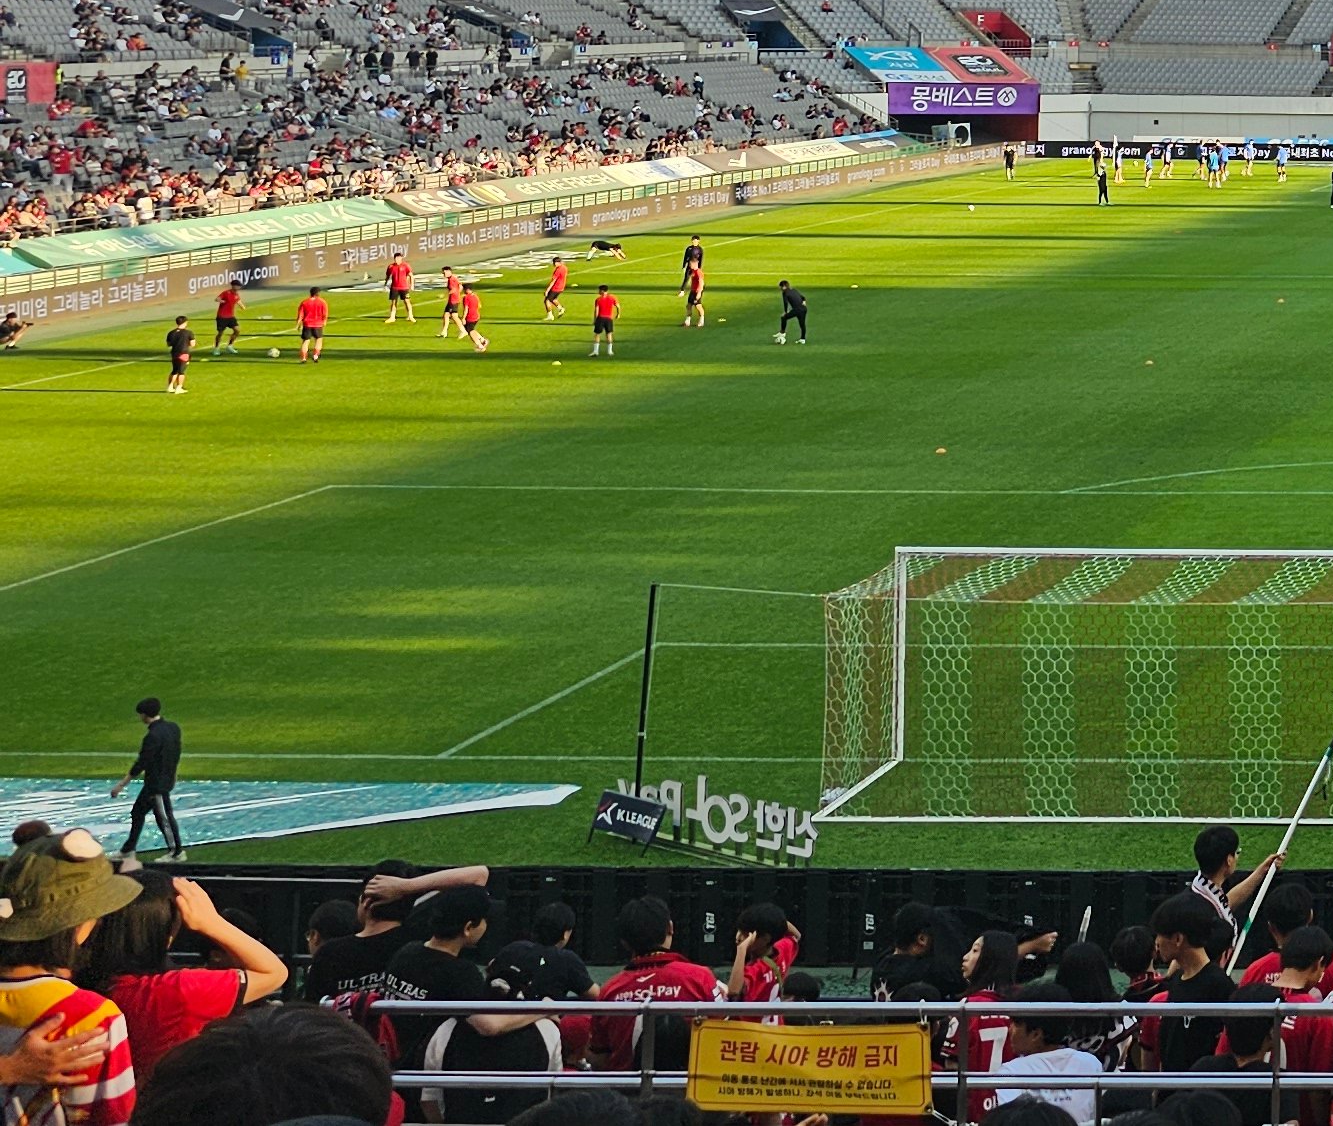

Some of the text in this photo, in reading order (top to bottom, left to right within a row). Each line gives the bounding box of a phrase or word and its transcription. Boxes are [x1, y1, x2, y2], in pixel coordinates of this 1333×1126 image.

[910, 85, 995, 113] 몽베스트
[391, 241, 410, 261] Day
[418, 235, 455, 254] 국내최초
[456, 231, 478, 247] No.1
[479, 225, 510, 243] 프리미엄
[188, 262, 279, 296] granology.com
[52, 276, 168, 314] 그래놀라 그라놀로지
[626, 811, 658, 831] LEAGUE
[386, 973, 429, 1000] ULTRAS
[720, 1039, 898, 1069] 관람 시야 방해 금지
